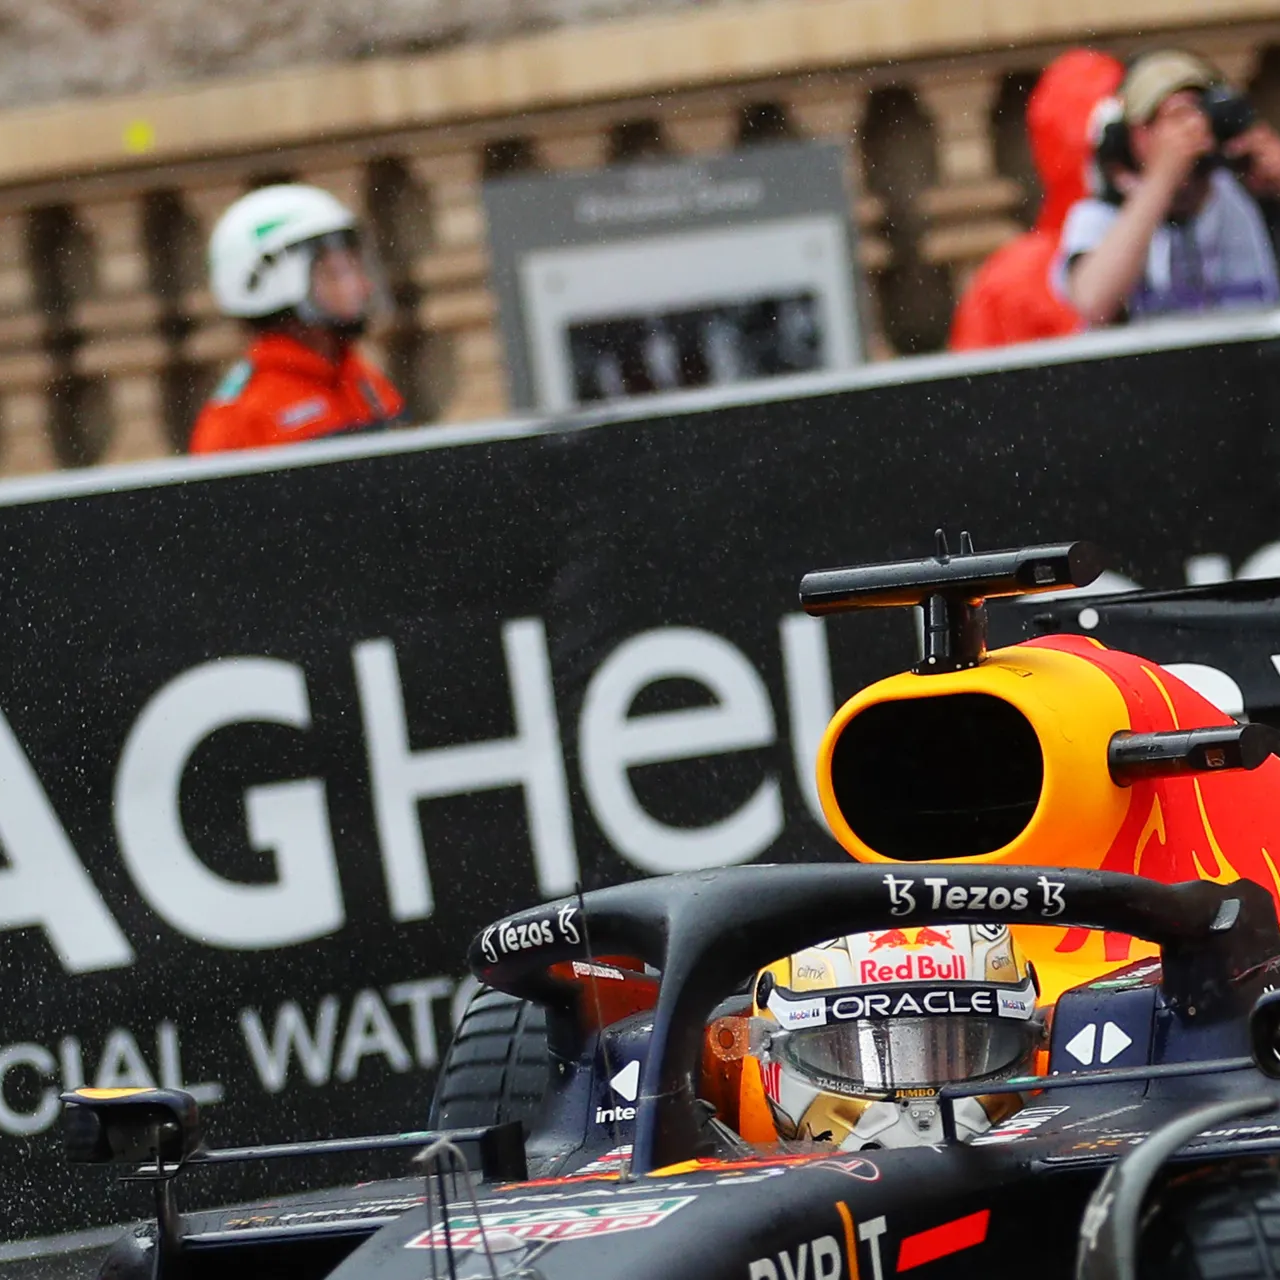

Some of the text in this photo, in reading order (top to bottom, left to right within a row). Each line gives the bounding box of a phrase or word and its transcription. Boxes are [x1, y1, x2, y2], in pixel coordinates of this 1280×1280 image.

[924, 878, 1029, 910] Tezos
[498, 920, 554, 953] Tezos
[860, 955, 965, 983] Red Bull
[832, 991, 992, 1019] ORACLE
[894, 1088, 936, 1098] JUMBO
[596, 1106, 639, 1123] inte
[430, 1216, 650, 1244] HUER
